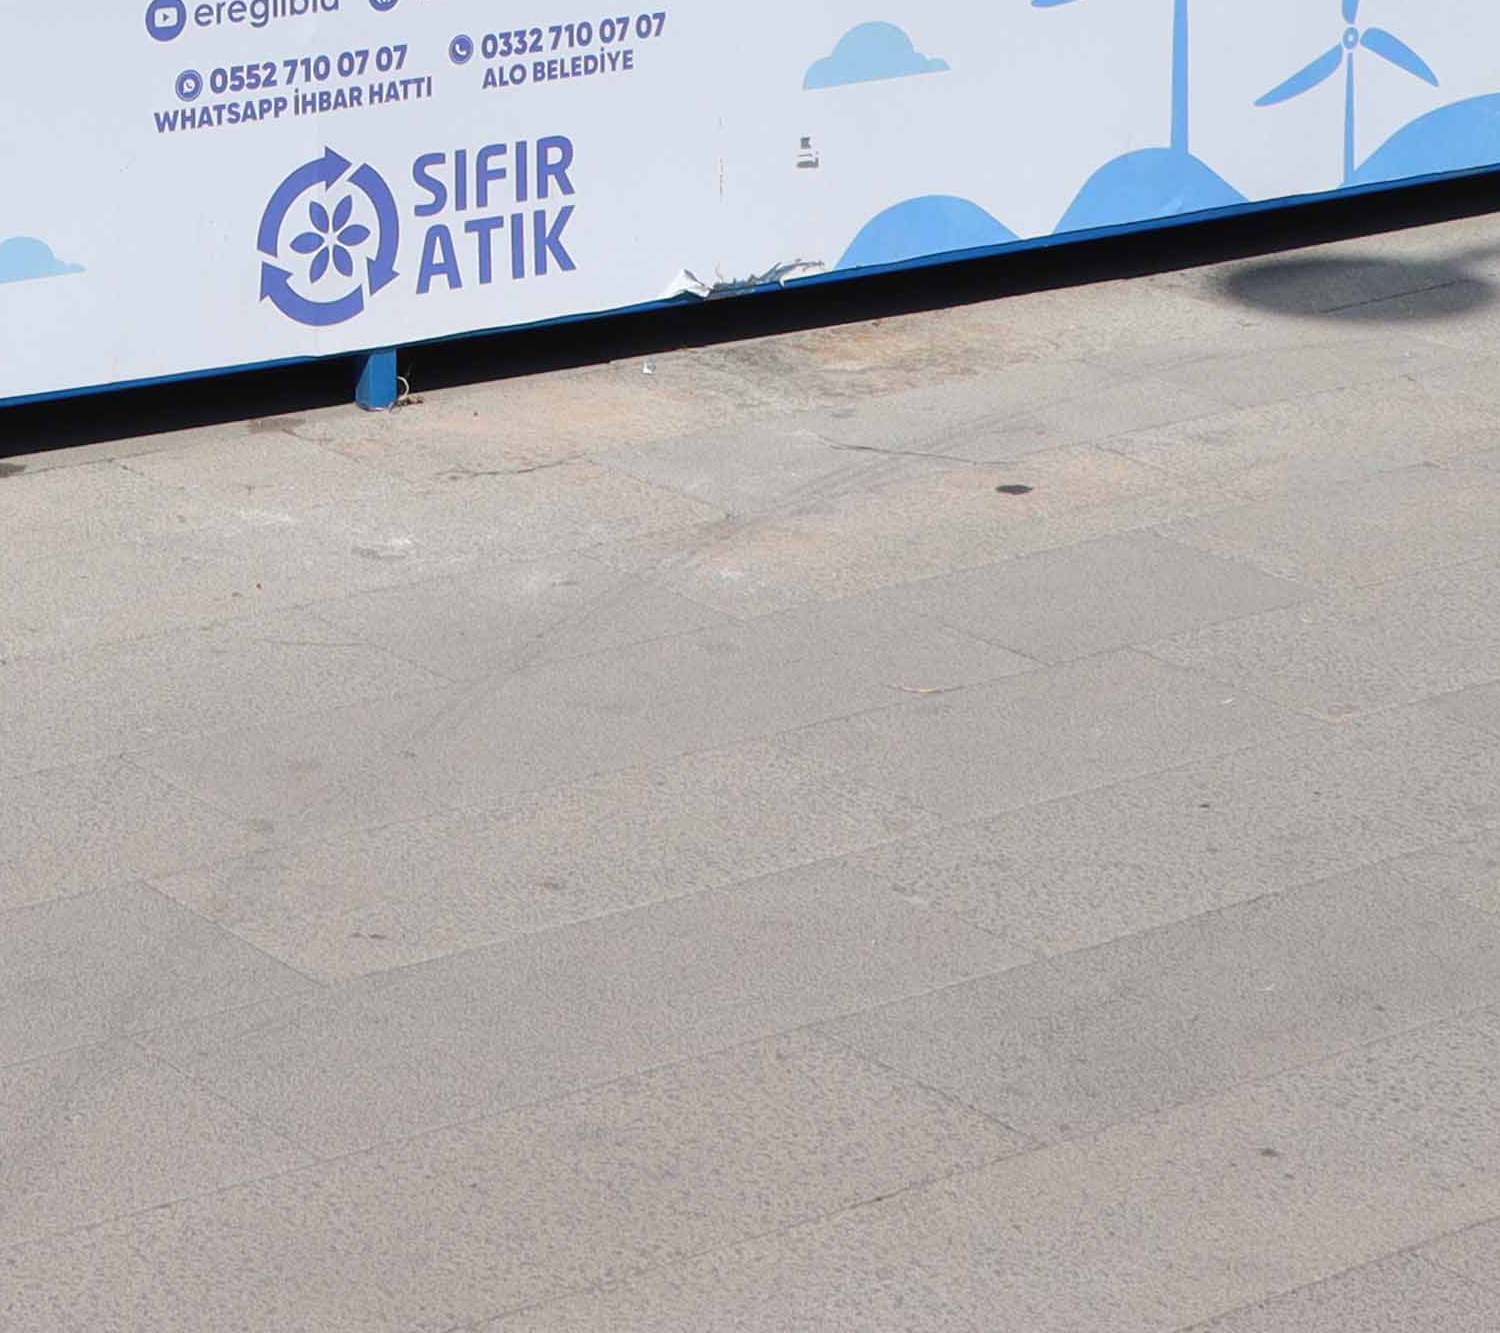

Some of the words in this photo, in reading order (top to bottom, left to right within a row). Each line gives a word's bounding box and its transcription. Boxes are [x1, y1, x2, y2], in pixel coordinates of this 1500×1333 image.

[480, 27, 544, 60] 0332
[548, 21, 593, 52] 710
[598, 16, 631, 45] 07
[635, 12, 667, 40] 07
[209, 60, 278, 95] 0552
[284, 54, 331, 86] 710
[337, 49, 370, 78] 07
[375, 43, 409, 73] 07
[481, 63, 527, 90] ALO
[532, 46, 634, 82] BELEDİYE
[154, 95, 288, 134] WHATSAPP
[293, 87, 363, 116] İHBAR
[368, 76, 433, 106] HATTI
[412, 134, 576, 217] SIFIR
[415, 204, 577, 294] ATIK
